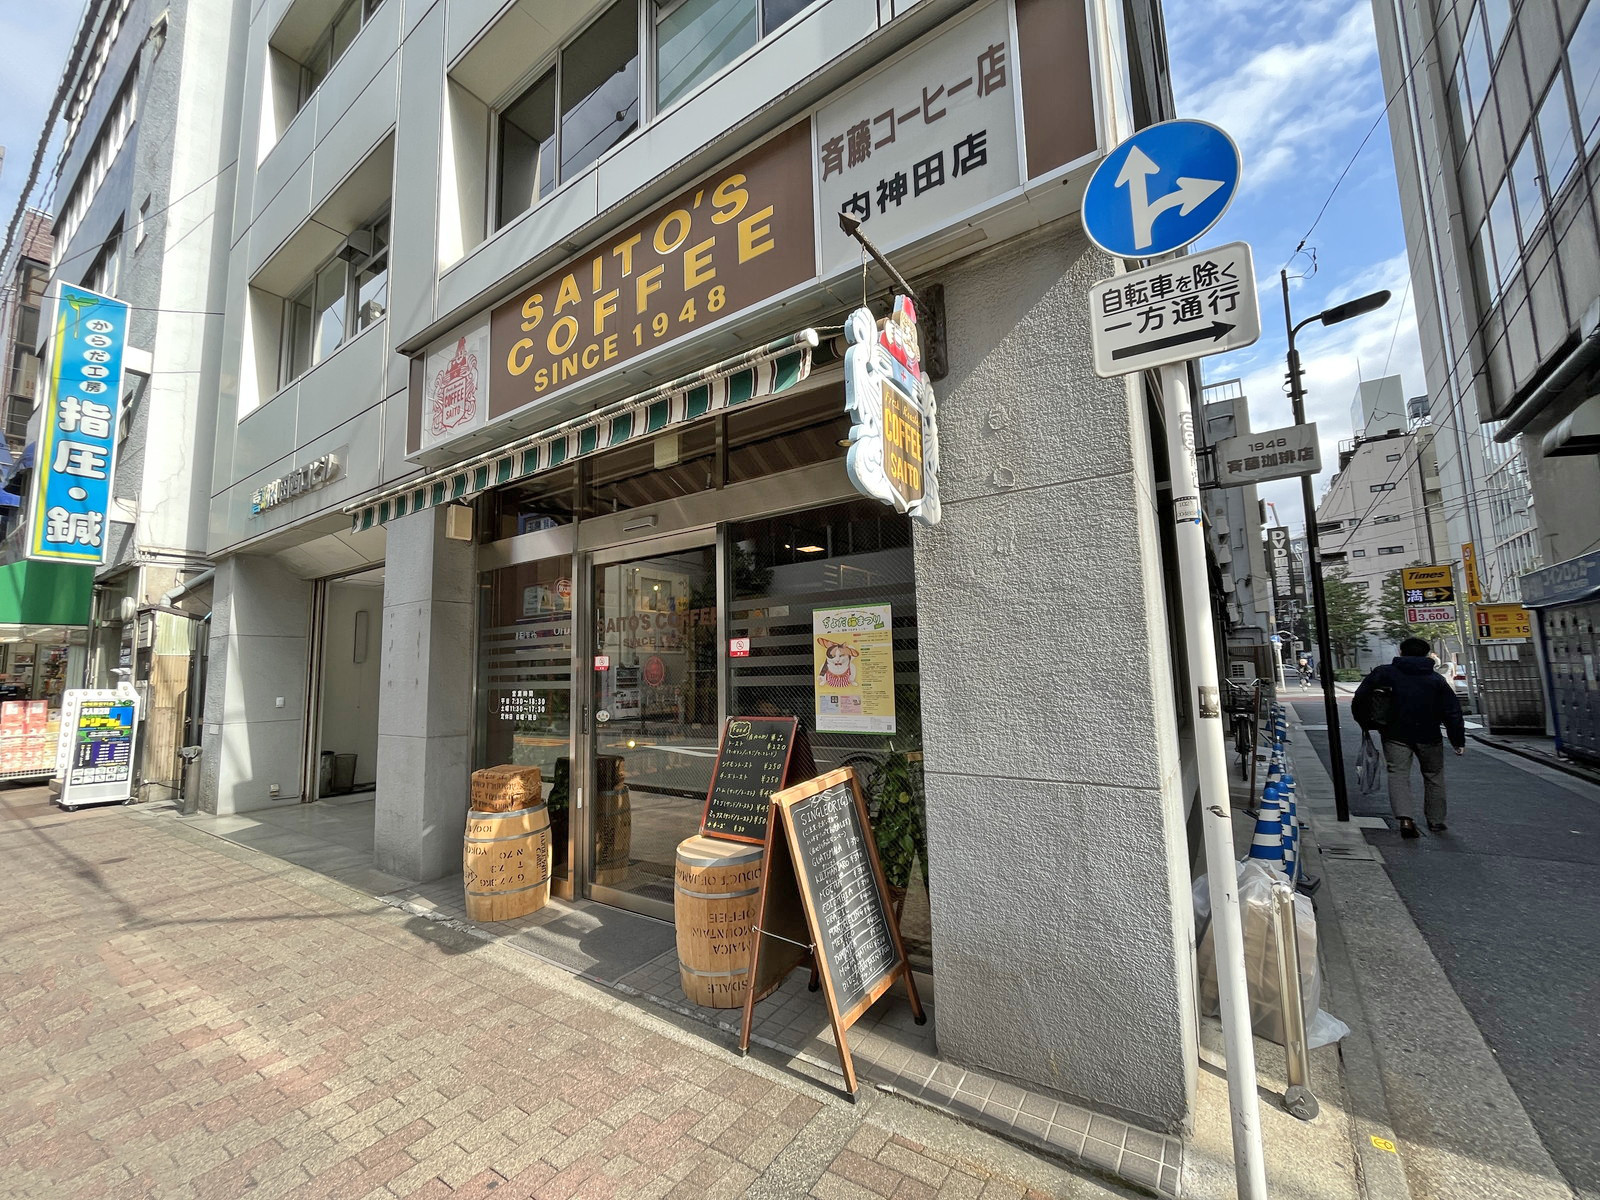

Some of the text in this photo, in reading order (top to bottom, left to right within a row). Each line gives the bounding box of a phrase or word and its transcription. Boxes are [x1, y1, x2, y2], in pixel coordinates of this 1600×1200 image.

[822, 42, 1006, 182] 斉藤コーヒー店
[842, 130, 987, 223] 内神田店
[521, 174, 749, 332] SAITO'S
[507, 205, 775, 376] COFFEE
[1102, 261, 1237, 313] 自転車を除く
[1104, 285, 1240, 333] 一方通行
[85, 321, 109, 392] からだ工房
[534, 285, 726, 392] SINCE 1948
[445, 388, 464, 408] COFFEE
[446, 406, 460, 420] SAITO
[885, 408, 922, 463] COFFEE
[1248, 438, 1287, 452] 1948
[891, 452, 919, 490] SAITO
[1227, 447, 1314, 474] 斉藤珈琲店
[1406, 590, 1423, 602] 満
[1409, 572, 1445, 580] Times
[1418, 612, 1450, 621] 3,600
